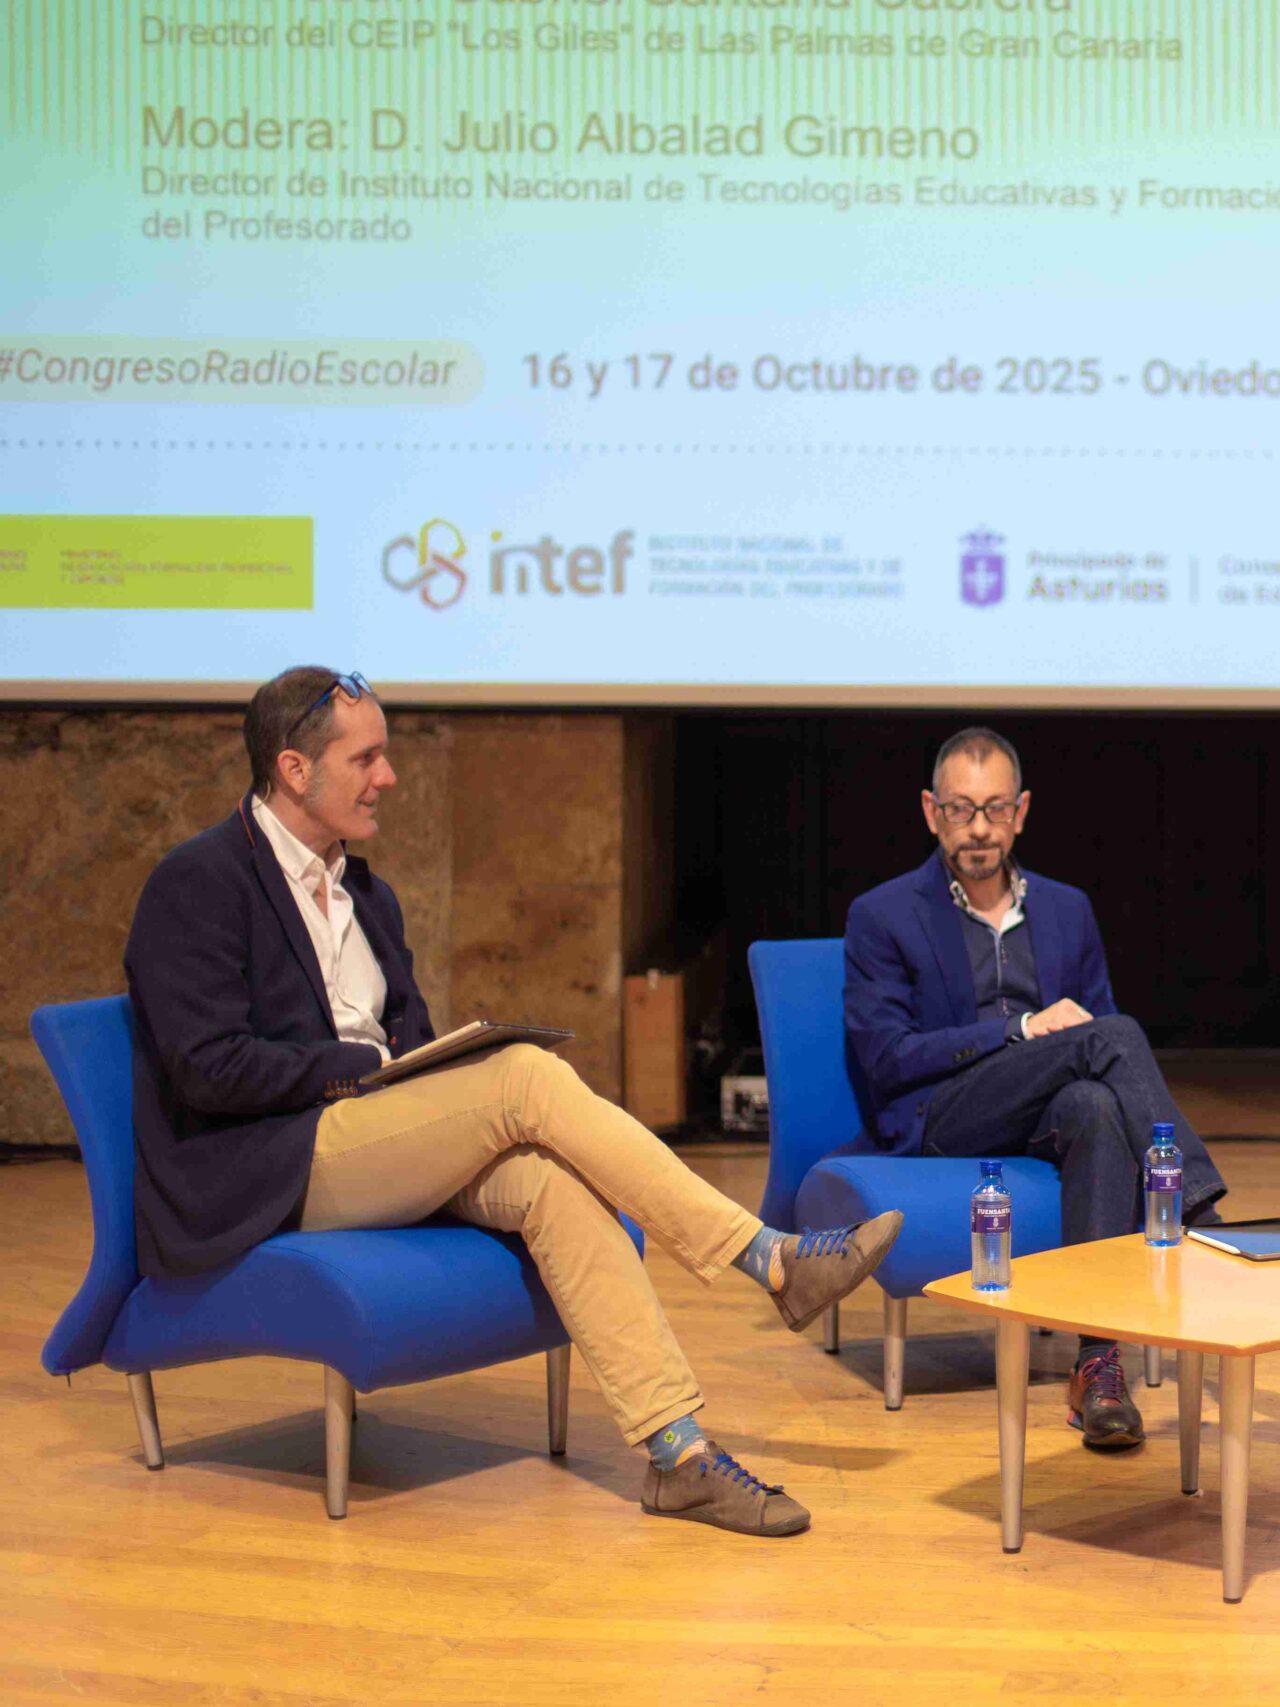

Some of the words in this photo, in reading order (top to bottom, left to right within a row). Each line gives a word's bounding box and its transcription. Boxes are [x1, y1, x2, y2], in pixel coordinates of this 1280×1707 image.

[140, 16, 275, 46] Director
[286, 18, 335, 48] del
[348, 19, 434, 49] CEIP
[446, 20, 520, 51] "Los
[533, 22, 632, 52] Giles"
[644, 25, 685, 53] de
[695, 26, 757, 54] Las
[769, 25, 895, 55] Palmas
[905, 29, 946, 57] de
[959, 29, 1040, 58] Gran
[1052, 30, 1182, 60] Canaria
[141, 105, 349, 151] Modera:
[370, 108, 423, 153] D.
[443, 109, 558, 156] Julio
[577, 111, 763, 157] Albalad
[783, 114, 978, 160] Gimeno
[141, 166, 274, 196] Director
[286, 168, 327, 198] de
[339, 170, 473, 199] Instituto
[485, 172, 632, 202] Nacional
[644, 174, 685, 202] de
[699, 174, 902, 211] Tecnologías
[916, 176, 1098, 208] Educativas
[1108, 187, 1127, 214] y
[141, 211, 190, 239] del
[204, 210, 411, 242] Profesorado
[0, 349, 457, 393] #CongresoRadioEscolar
[522, 354, 572, 390] 16
[586, 364, 610, 396] y
[623, 354, 673, 391] 17
[688, 355, 738, 392] de
[752, 354, 918, 393] Octubre
[932, 356, 983, 394] de
[996, 358, 1101, 395] 2025
[1028, 574, 1168, 602] Asturias
